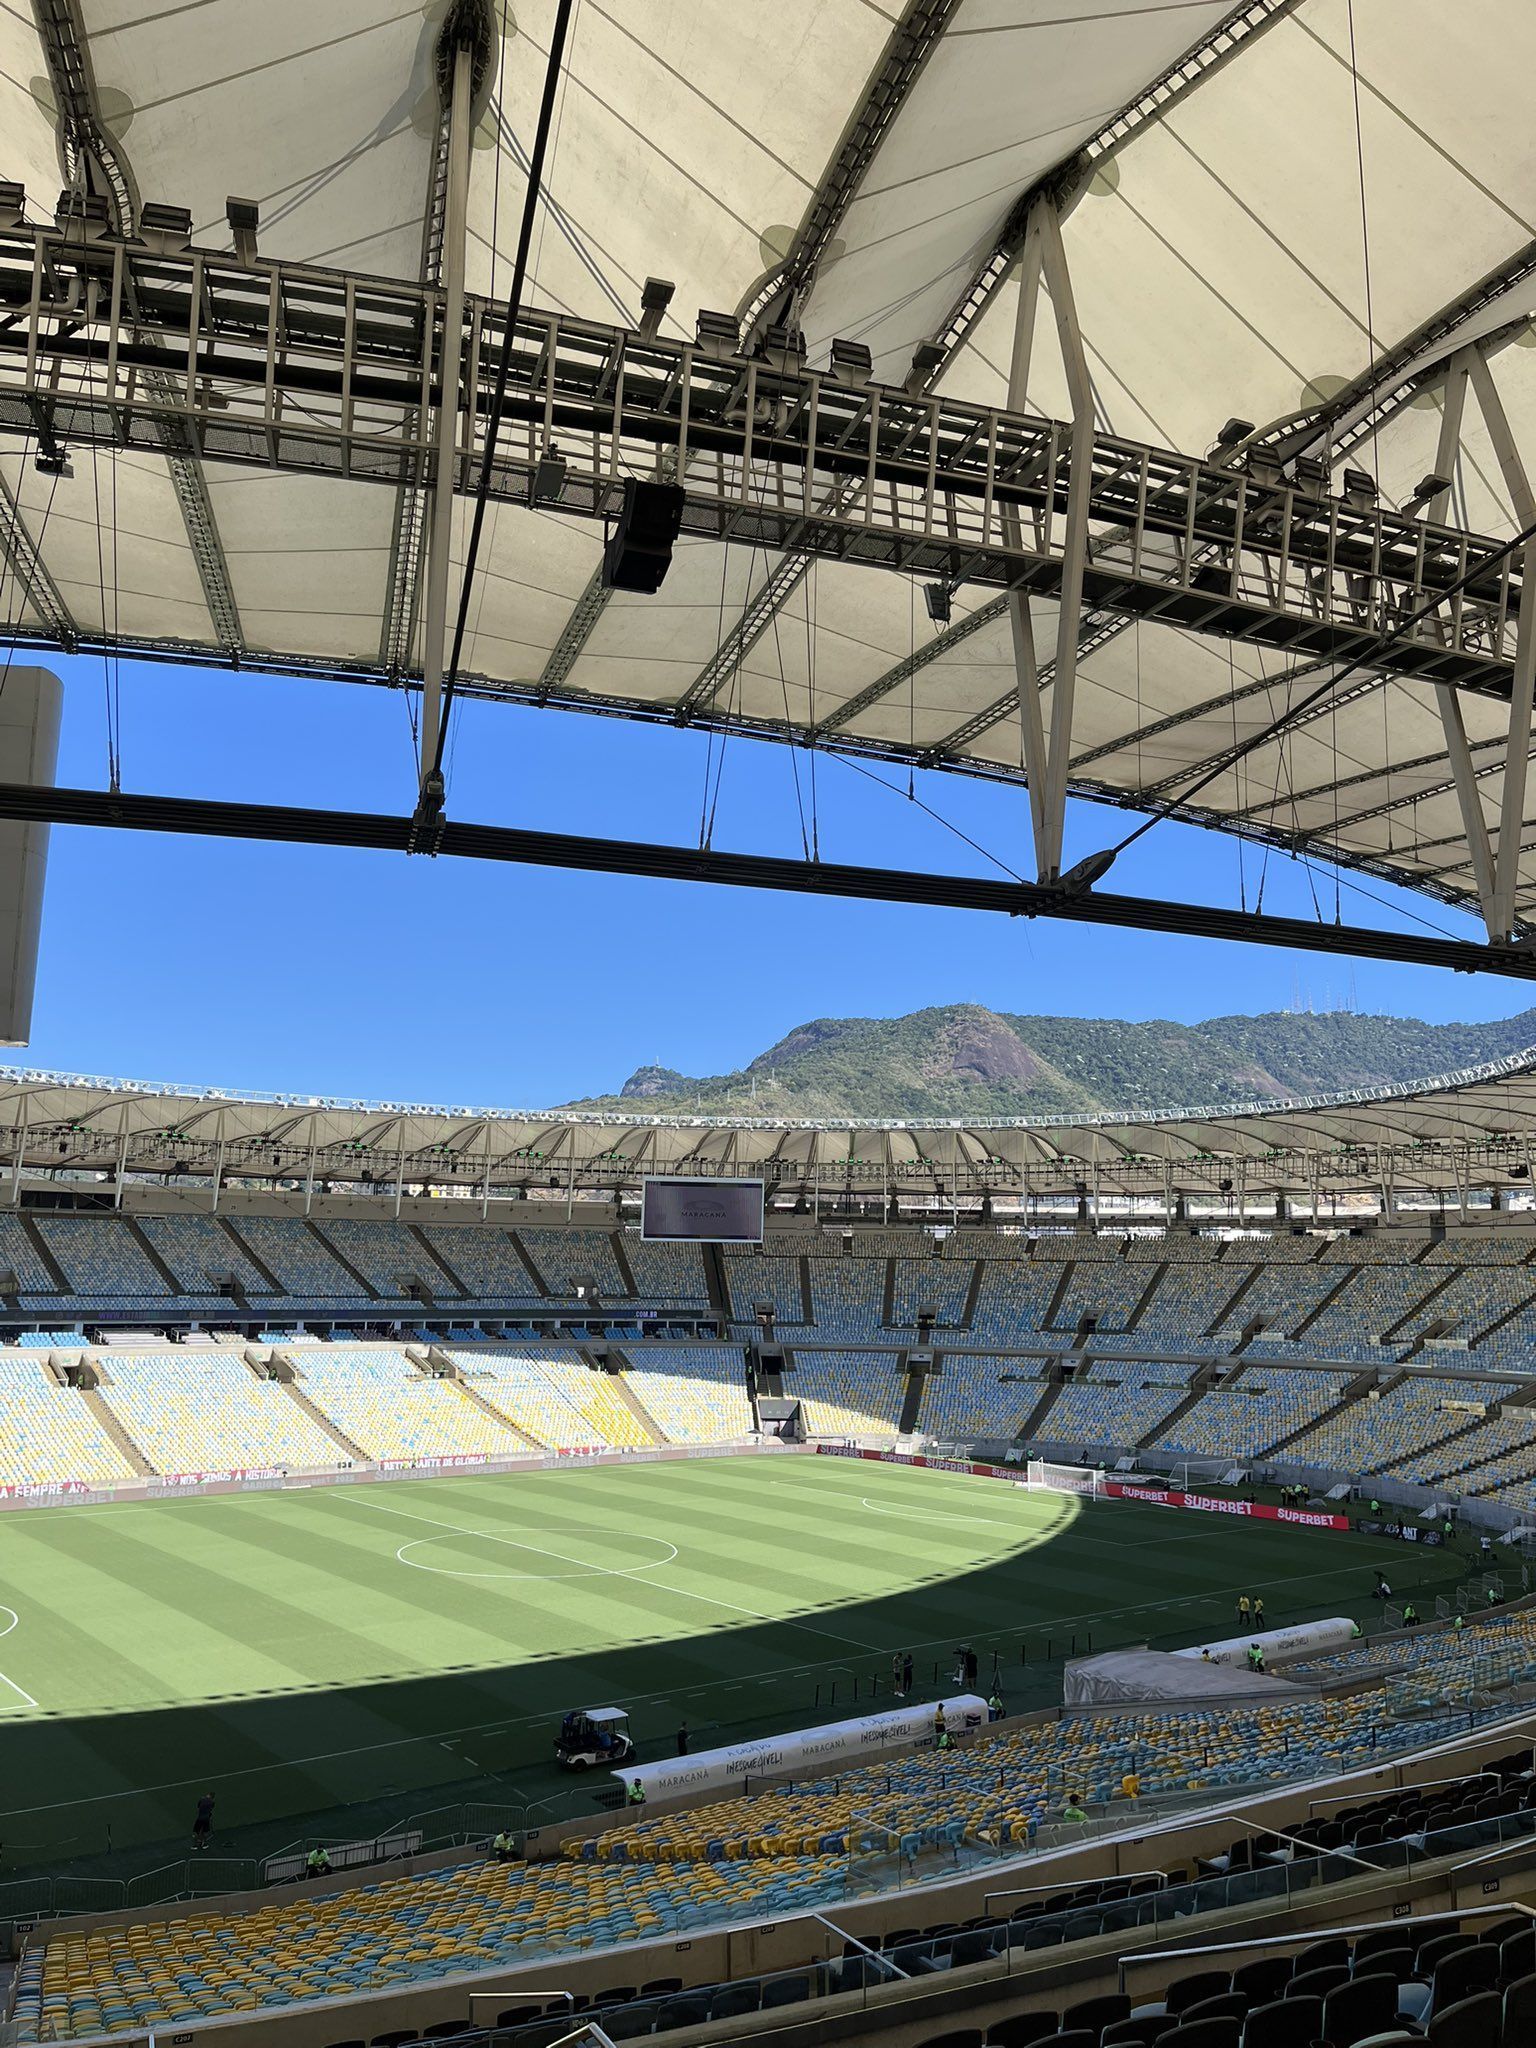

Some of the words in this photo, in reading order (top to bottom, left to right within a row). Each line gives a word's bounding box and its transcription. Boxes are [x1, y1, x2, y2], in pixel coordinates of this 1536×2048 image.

[688, 1447, 738, 1458] SUPERBET
[820, 1446, 864, 1458] SUPERBET
[880, 1453, 915, 1463] SUPERBET
[926, 1459, 974, 1473] SUPERBET
[992, 1468, 1029, 1481] SUPERBE
[1122, 1486, 1168, 1501] SUPERBET
[1184, 1494, 1253, 1515] SUPERBET
[1277, 1508, 1334, 1526] SUPERBET
